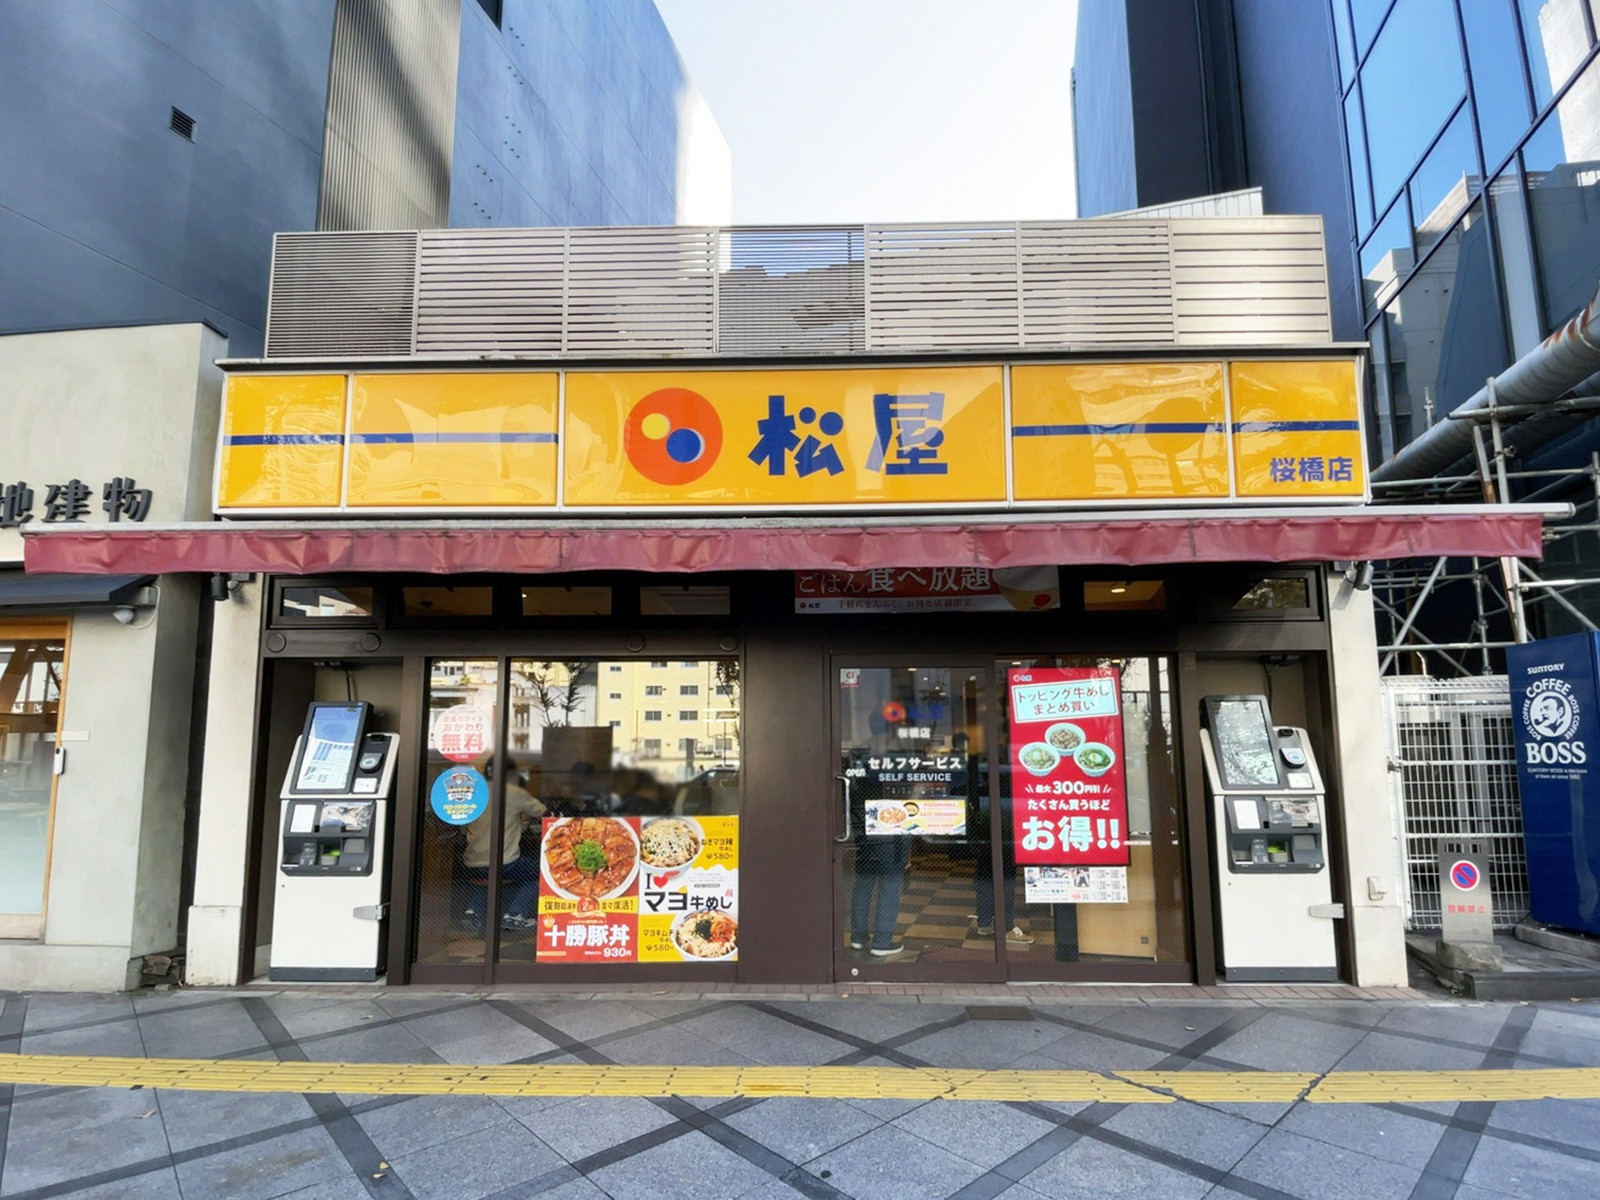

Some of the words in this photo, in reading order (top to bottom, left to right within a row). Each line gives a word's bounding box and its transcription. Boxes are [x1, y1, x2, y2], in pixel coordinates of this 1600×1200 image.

[748, 391, 948, 478] 松屋
[1269, 456, 1353, 482] 桜橋店
[1527, 663, 1565, 674] SUNTORY
[1018, 685, 1109, 703] トッピング牛めし
[1526, 678, 1572, 698] COFFEE
[1034, 700, 1095, 715] まとめ買い
[443, 723, 483, 732] おかわり
[441, 733, 484, 752] 無料
[1525, 741, 1587, 764] BOSS
[868, 757, 962, 769] セルフサービス
[879, 773, 903, 781] SELF
[907, 773, 952, 781] SERVICE
[1027, 799, 1111, 811] たくさん買うほど
[646, 873, 651, 889] I
[644, 892, 733, 912] マヨ牛めし
[544, 924, 631, 947] 十勝豚丼
